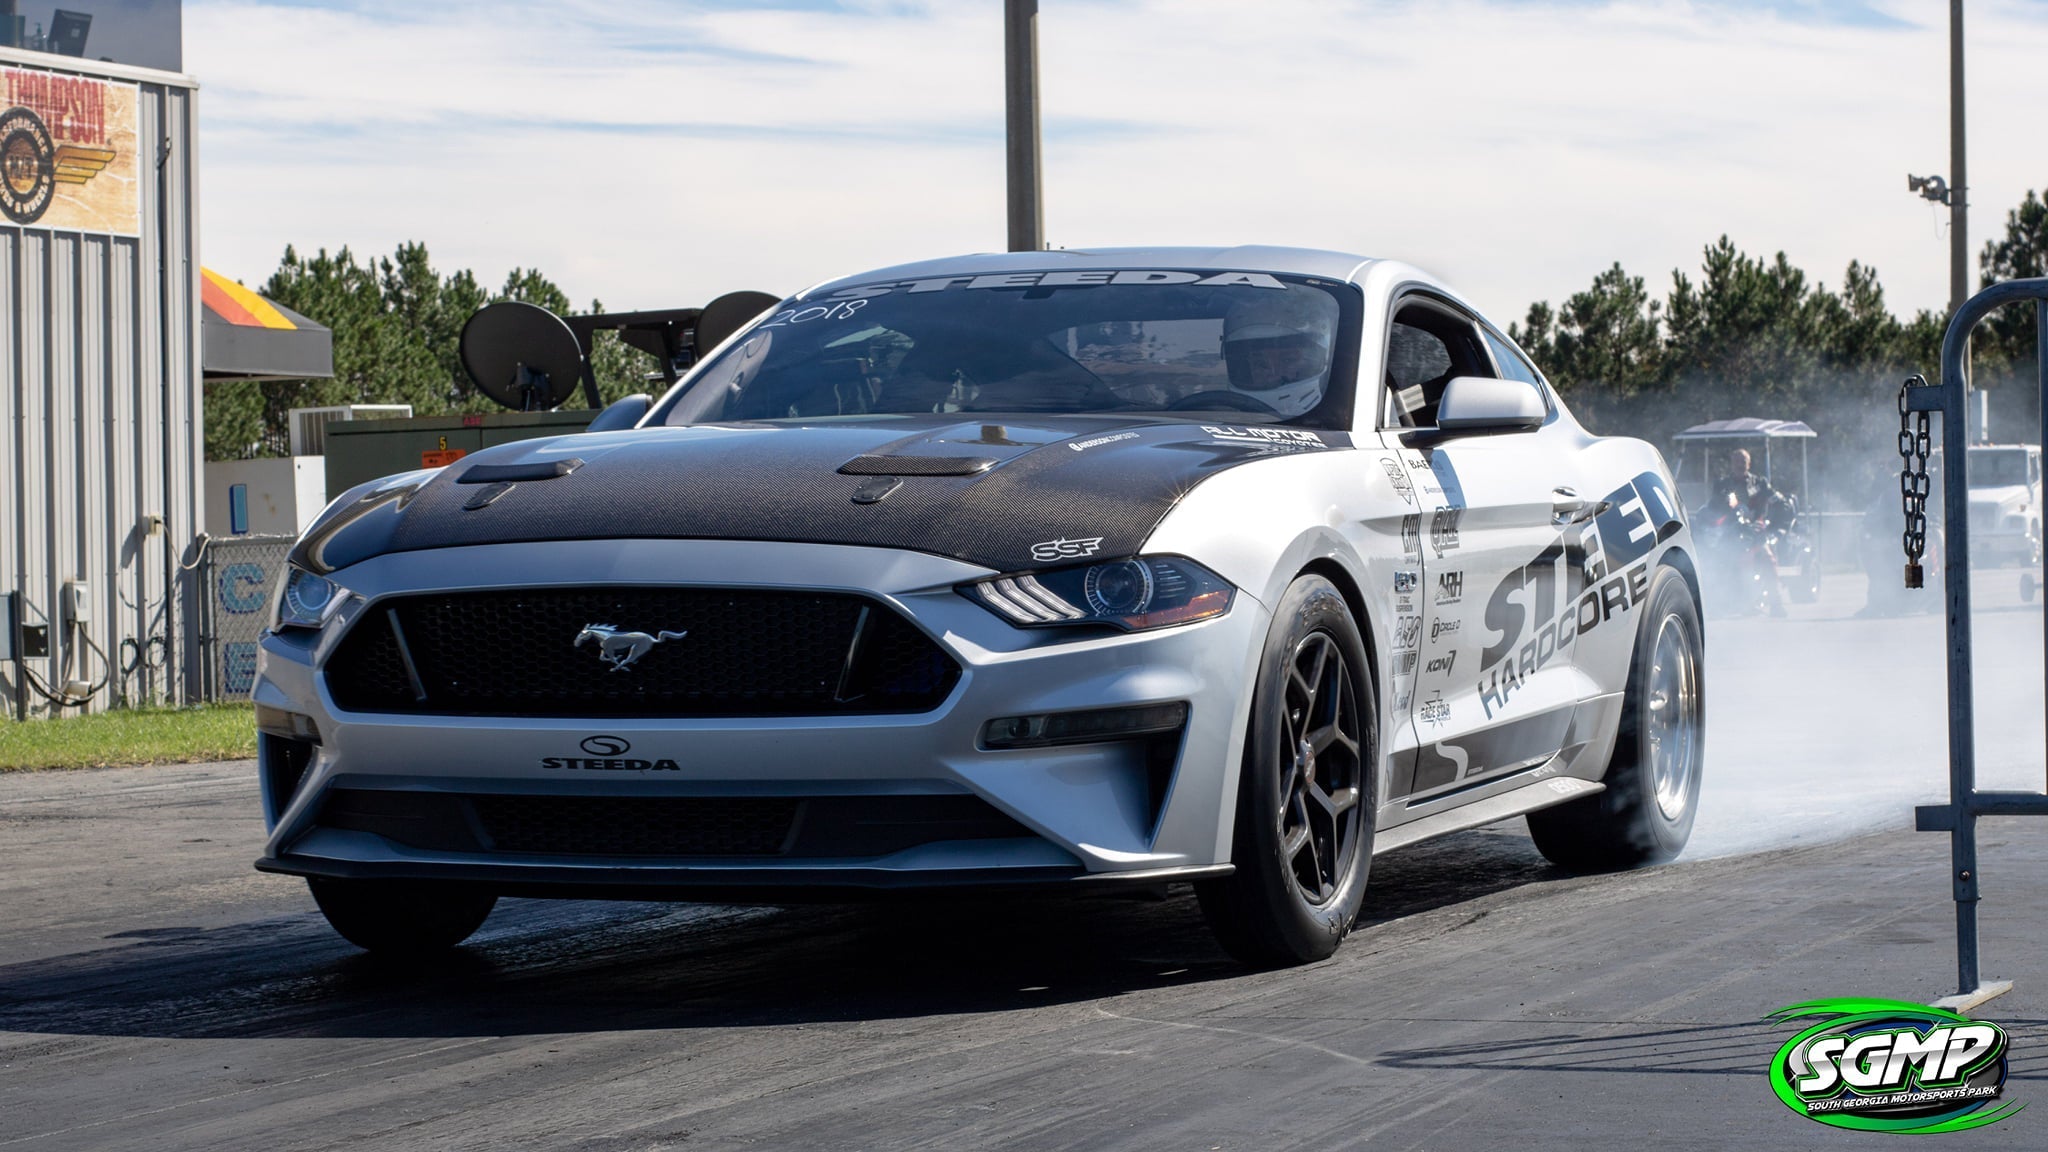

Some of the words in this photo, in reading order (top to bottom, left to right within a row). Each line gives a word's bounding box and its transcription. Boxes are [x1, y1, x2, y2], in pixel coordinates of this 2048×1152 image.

[5, 69, 104, 144] THOMPSON
[826, 272, 1288, 302] STEEDA
[758, 299, 868, 329] 2018
[440, 436, 447, 450] 5
[1200, 425, 1247, 437] ALL
[1246, 428, 1322, 442] MOTOR
[1031, 537, 1103, 562] SSF
[1477, 561, 1648, 720] HARDCORE
[1425, 650, 1457, 677] KONI
[542, 758, 681, 771] STEEDA
